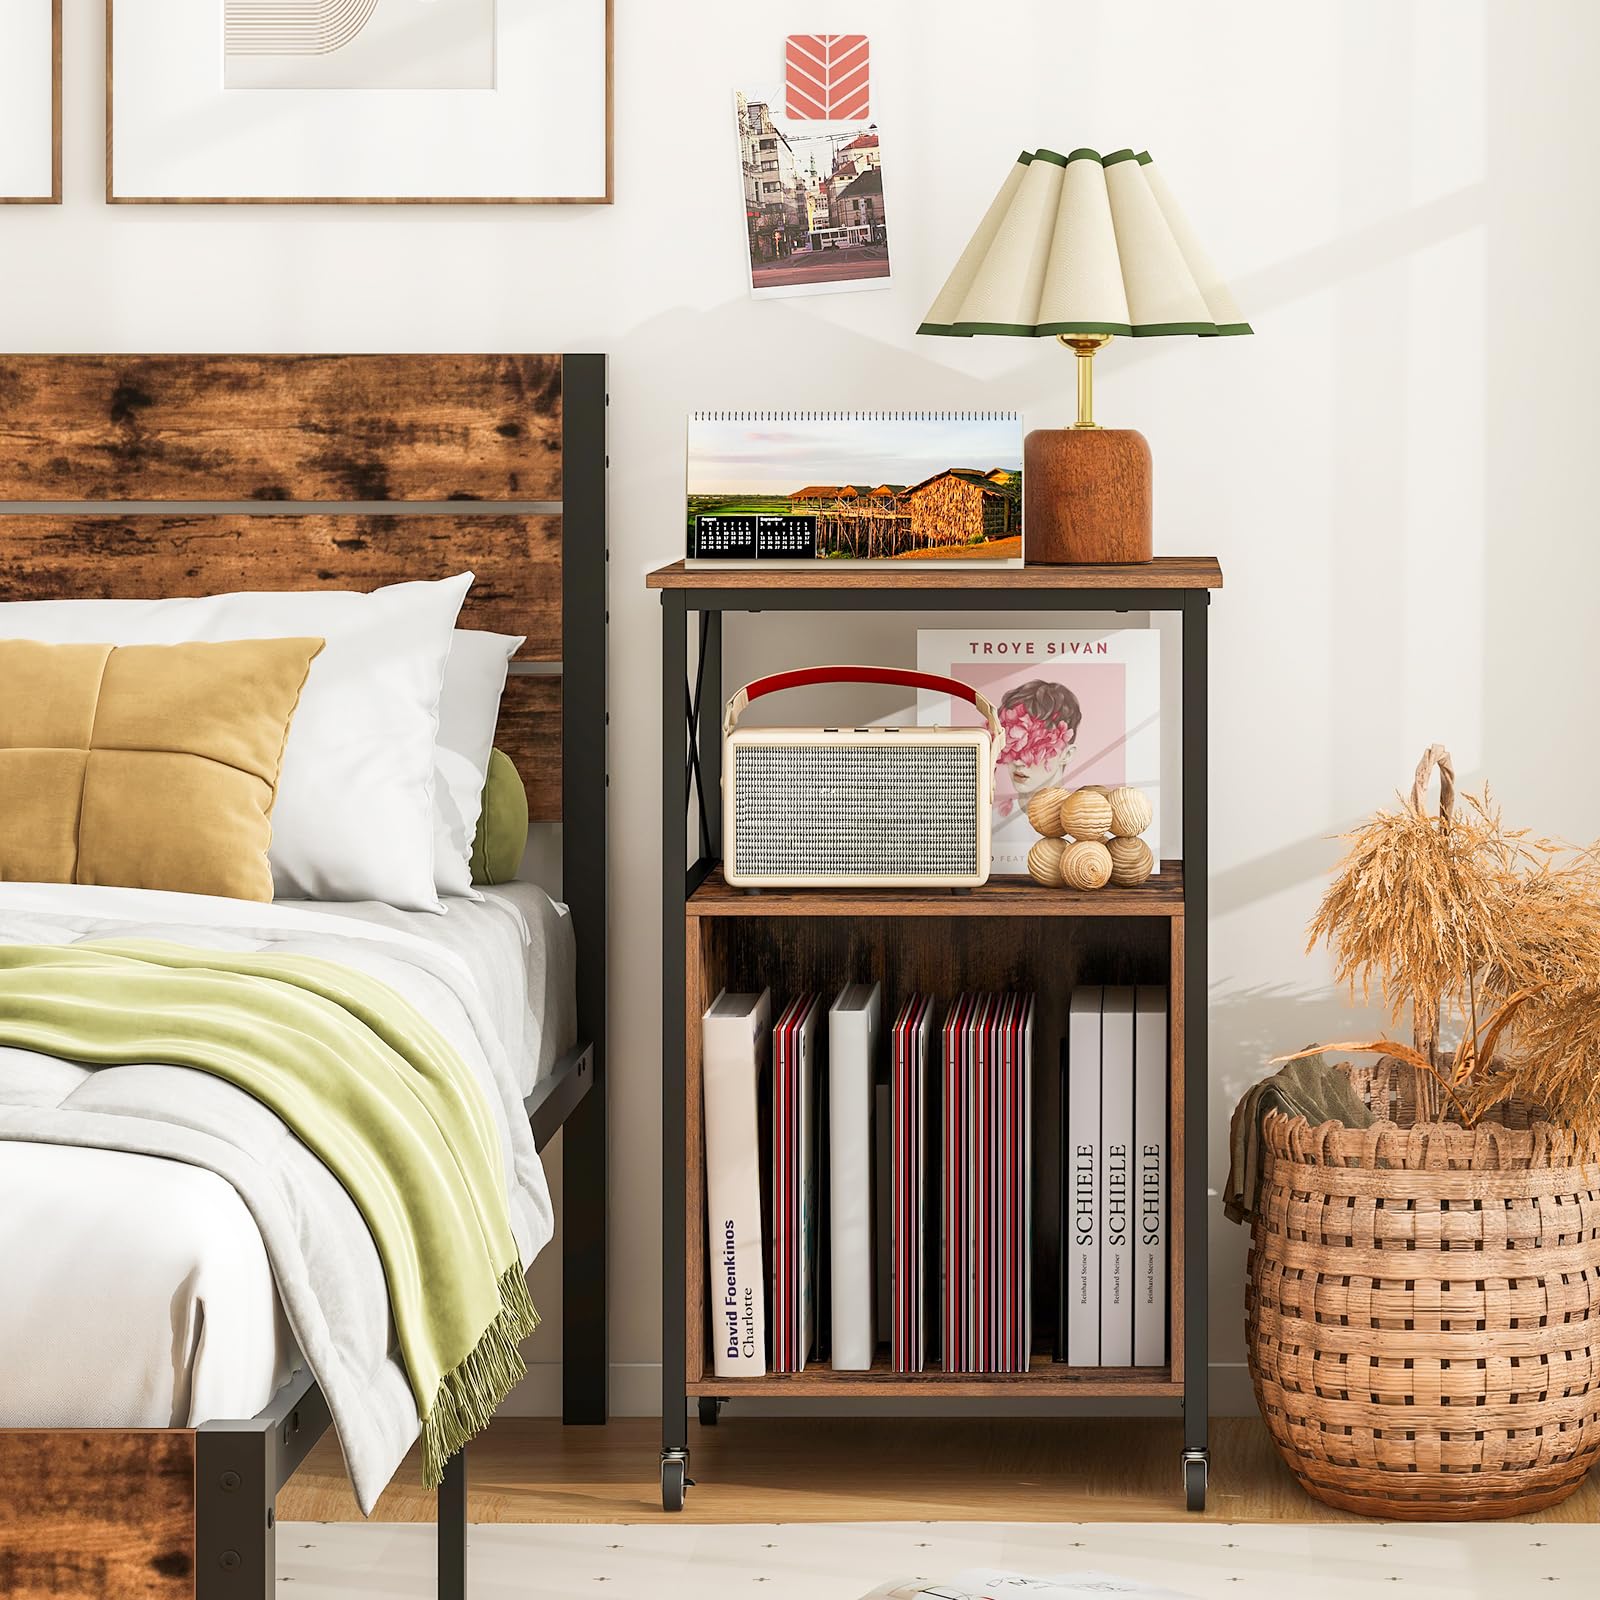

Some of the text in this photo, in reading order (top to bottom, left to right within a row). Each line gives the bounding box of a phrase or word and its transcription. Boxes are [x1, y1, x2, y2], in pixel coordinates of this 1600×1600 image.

[969, 642, 1107, 654] TROYE SIVAN
[1076, 1144, 1093, 1246] SCHIELE
[1109, 1144, 1126, 1246] SCHIELE
[1143, 1144, 1160, 1246] SCHIELE
[723, 1219, 739, 1358] David Foenkinos
[742, 1287, 755, 1359] Charlotte
